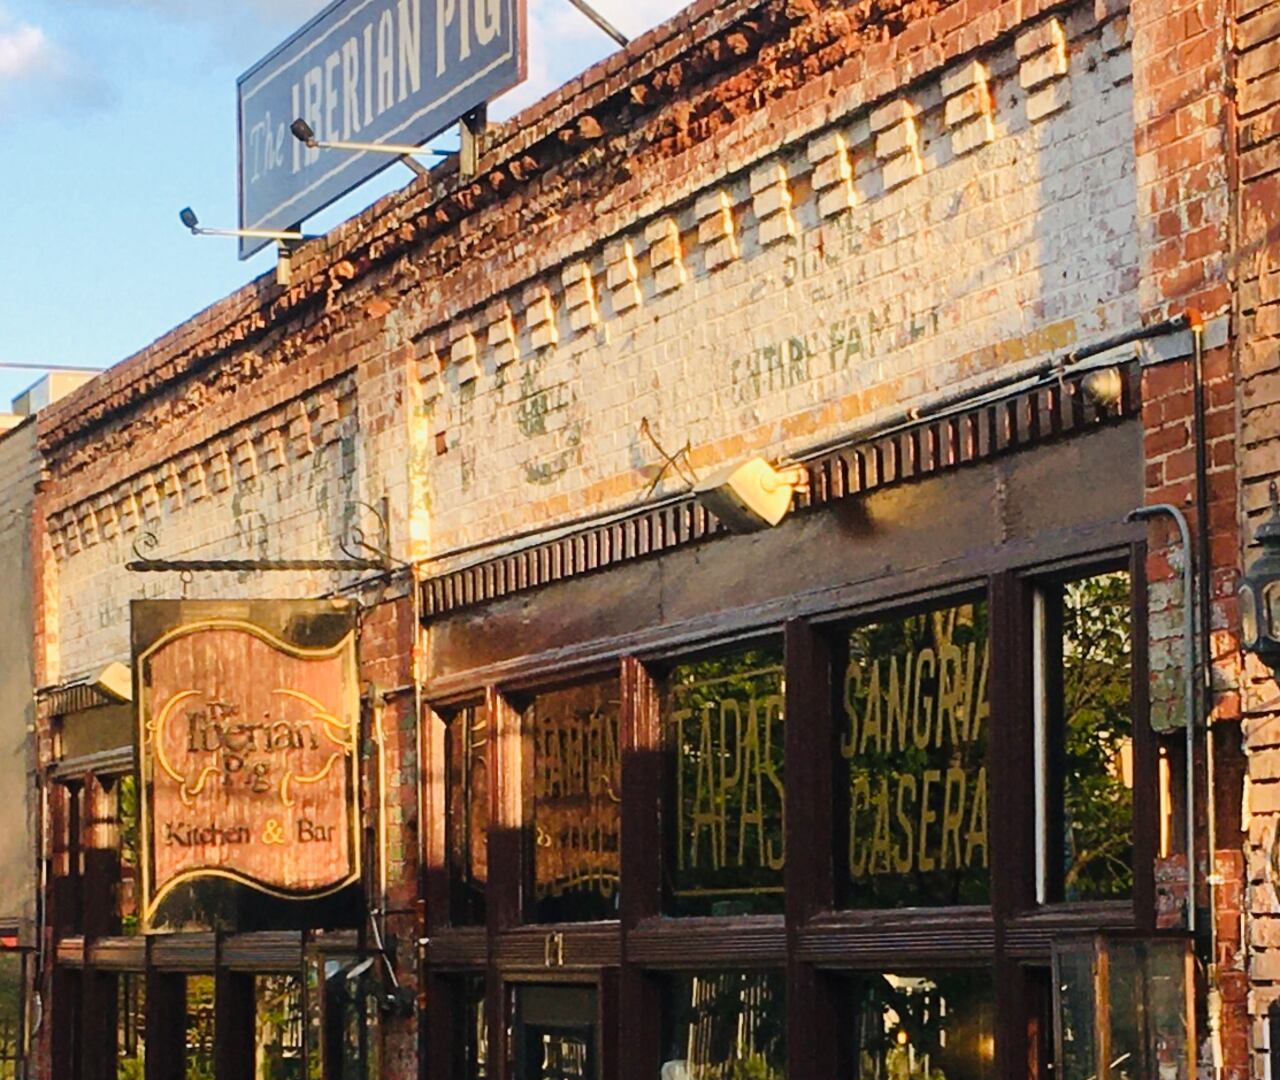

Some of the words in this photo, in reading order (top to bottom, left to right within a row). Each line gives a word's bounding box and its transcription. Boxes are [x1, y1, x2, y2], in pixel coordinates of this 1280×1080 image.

[250, 110, 287, 185] The
[290, 0, 422, 176] IBERIAN
[186, 708, 319, 753] Iberian
[206, 701, 240, 720] The
[841, 640, 990, 758] SANGRIA
[223, 753, 272, 793] Pig
[672, 695, 786, 872] TAPAS
[165, 820, 250, 848] Kitchen
[261, 818, 285, 845] &
[298, 818, 336, 843] Bar
[849, 766, 989, 877] CASERA
